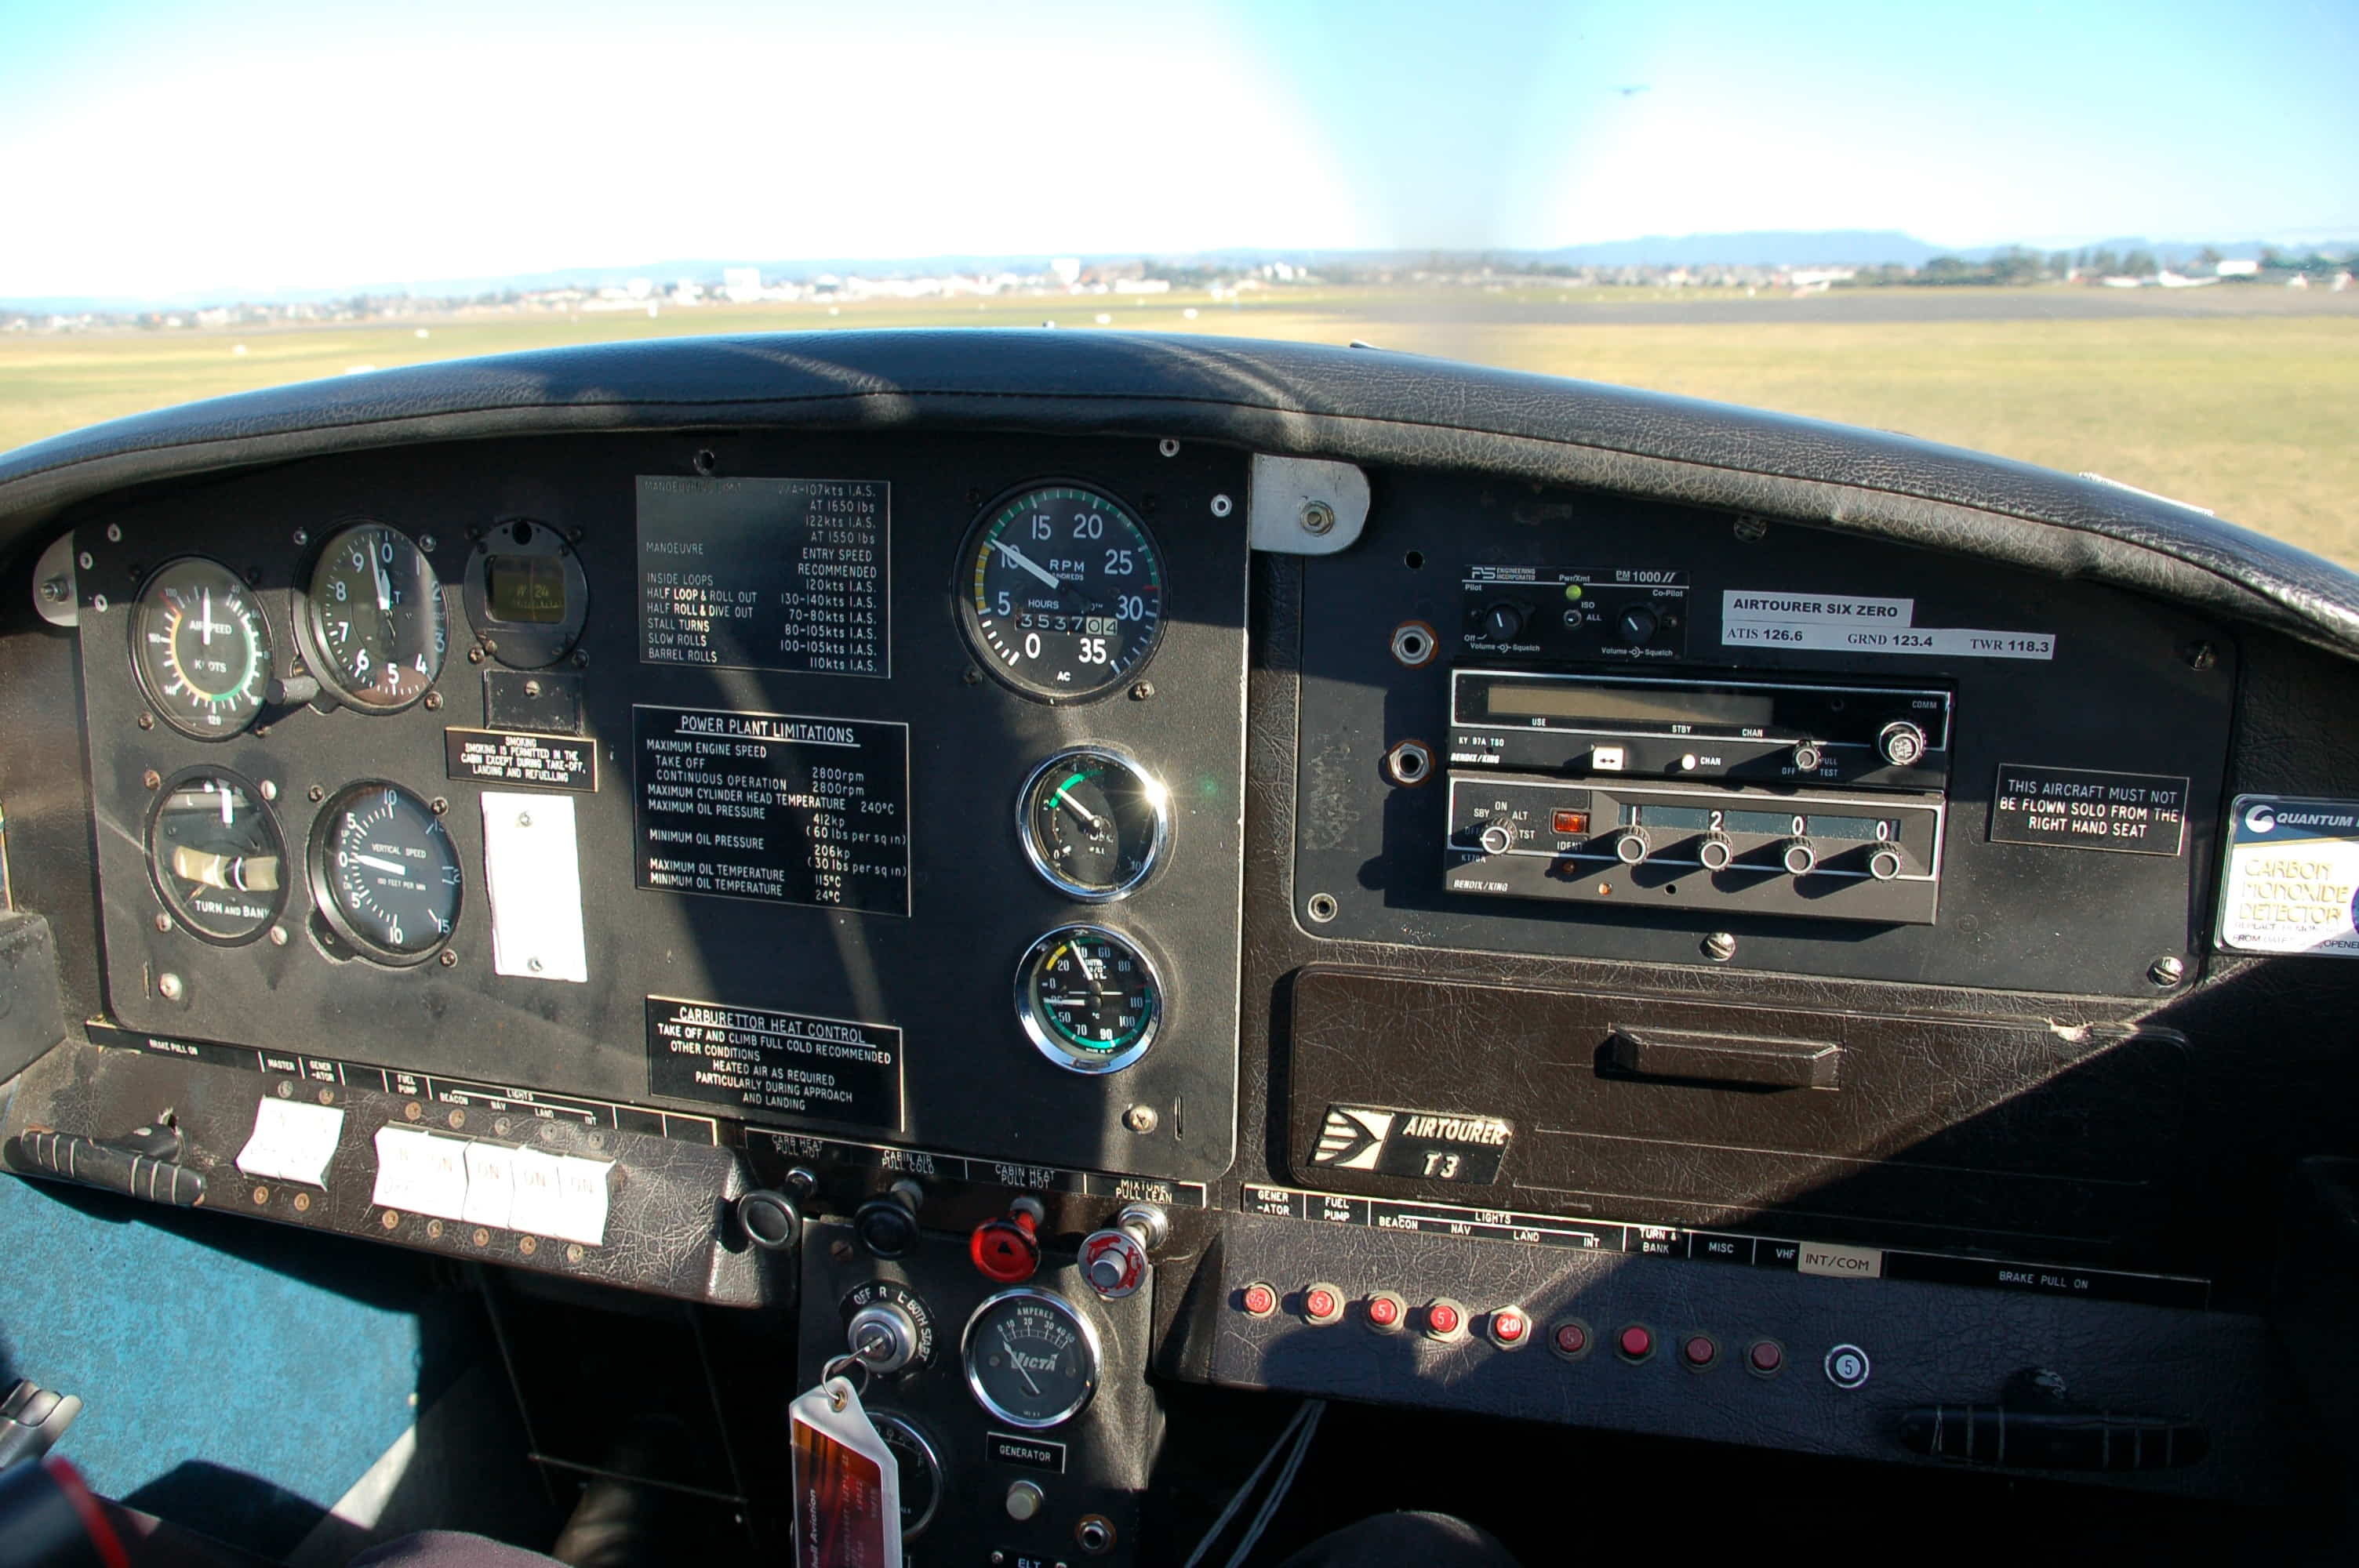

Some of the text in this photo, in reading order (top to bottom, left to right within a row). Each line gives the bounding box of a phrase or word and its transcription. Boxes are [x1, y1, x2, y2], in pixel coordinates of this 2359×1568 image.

[1031, 515, 1052, 540] 15
[1073, 514, 1103, 540] 20
[382, 543, 392, 563] 0
[646, 543, 703, 555] MANOEUVRE
[802, 548, 872, 561] ENTRY SPEED
[353, 553, 364, 572] 9
[1049, 559, 1085, 572] RPM
[1104, 549, 1133, 575] 25
[647, 573, 713, 586] INSIDE LOOPS
[798, 564, 877, 579] RECOMMENDED
[1632, 571, 1660, 583] 1000
[336, 581, 347, 601] 8
[647, 588, 758, 603] HALF LOOP & ROLL OUT
[1465, 583, 1482, 592] Pilot
[1652, 589, 1683, 597] Co-Pilot
[998, 591, 1010, 615] 5
[1028, 599, 1060, 609] HOURS
[1115, 595, 1143, 621] 30
[1733, 598, 1898, 618] AIRTOURER SIX ZERO
[339, 622, 349, 642] 7
[647, 618, 710, 633] STALL TURNS
[648, 633, 707, 647] SLOW ROLLS
[1025, 633, 1041, 659] 0
[1727, 628, 2049, 653] ATIS 126.6 GRND 123.4 TWR 118.3
[649, 648, 717, 662] BARREL ROLLS
[1078, 637, 1107, 664] 35
[357, 648, 369, 670] 6
[416, 654, 427, 673] 4
[388, 663, 399, 684] 5
[1912, 700, 1937, 710] COMM
[682, 716, 854, 743] POWER PLANT LIMITATIONS
[1532, 717, 1546, 727] USE
[1672, 724, 1692, 734] STBY
[1742, 728, 1763, 738] CHAN
[646, 739, 767, 758] MAXIMUM ENGINE SPEED
[656, 755, 705, 769] TAKE OFF
[1700, 757, 1721, 766] CHAN
[656, 770, 864, 797] CONTINUOUS OPERATION 2800rpm
[2008, 779, 2177, 804] THIS AIRCRAFT MUST NOT
[384, 789, 397, 805] 10
[648, 783, 846, 811] MAXIMUM CYLINDER HEAD TEMPERATURE
[1474, 808, 1490, 818] SBY
[1495, 800, 1507, 811] ON
[2000, 797, 2179, 822] BE FLOWN SOLO FROM THE
[1511, 810, 1528, 821] ALT
[2276, 812, 2354, 827] QUANTUM
[1518, 829, 1536, 840] TST
[2028, 816, 2147, 839] RIGHT HAND SEAT
[372, 844, 427, 858] VERTICAL SPEED
[1453, 879, 1509, 892] BENDIX/KING
[195, 900, 241, 916] TURN AND
[438, 919, 449, 933] 15
[390, 926, 403, 944] 10
[680, 1006, 866, 1044] CARBURETTOR HEAT CONTROL
[1100, 1029, 1113, 1040] 90
[658, 1022, 892, 1065] TAKE OFF AND CLIMB FULL COLD RECOMMENDED
[671, 1040, 761, 1062] OTHER CONDITIONS
[713, 1059, 835, 1087] HEATED AIR AS REQUIRED
[696, 1071, 853, 1103] PARTICULARLY DURING APPROACH
[440, 1092, 554, 1119] BEACON NAV LAND
[743, 1092, 805, 1111] AND LANDING
[1402, 1116, 1506, 1145] AIRTOURER
[994, 1164, 1056, 1181] CABIN HEAT
[1001, 1175, 1050, 1189] PULL HOT
[1121, 1179, 1167, 1193] MIXTURE
[1115, 1187, 1173, 1204] PULL LEAN
[1258, 1189, 1289, 1202] GENER
[1325, 1196, 1349, 1209] FUEL
[1324, 1210, 1350, 1222] PUMP
[1475, 1211, 1511, 1225] LIGHTS
[1379, 1216, 1600, 1249] BEACON NAV LAND INT
[1639, 1228, 1666, 1240] TURN
[1642, 1241, 1669, 1254] BANK
[1709, 1241, 1734, 1254] MISC
[1776, 1248, 1796, 1260] VHF
[1805, 1253, 1870, 1271] INT/COM
[1999, 1270, 2088, 1290] BRAKE PULL ON
[907, 1299, 929, 1327] BOTH
[1502, 1319, 1521, 1332] 20
[918, 1327, 932, 1362] START
[1845, 1359, 1852, 1375] 5
[999, 1444, 1051, 1462] GENERATOR
